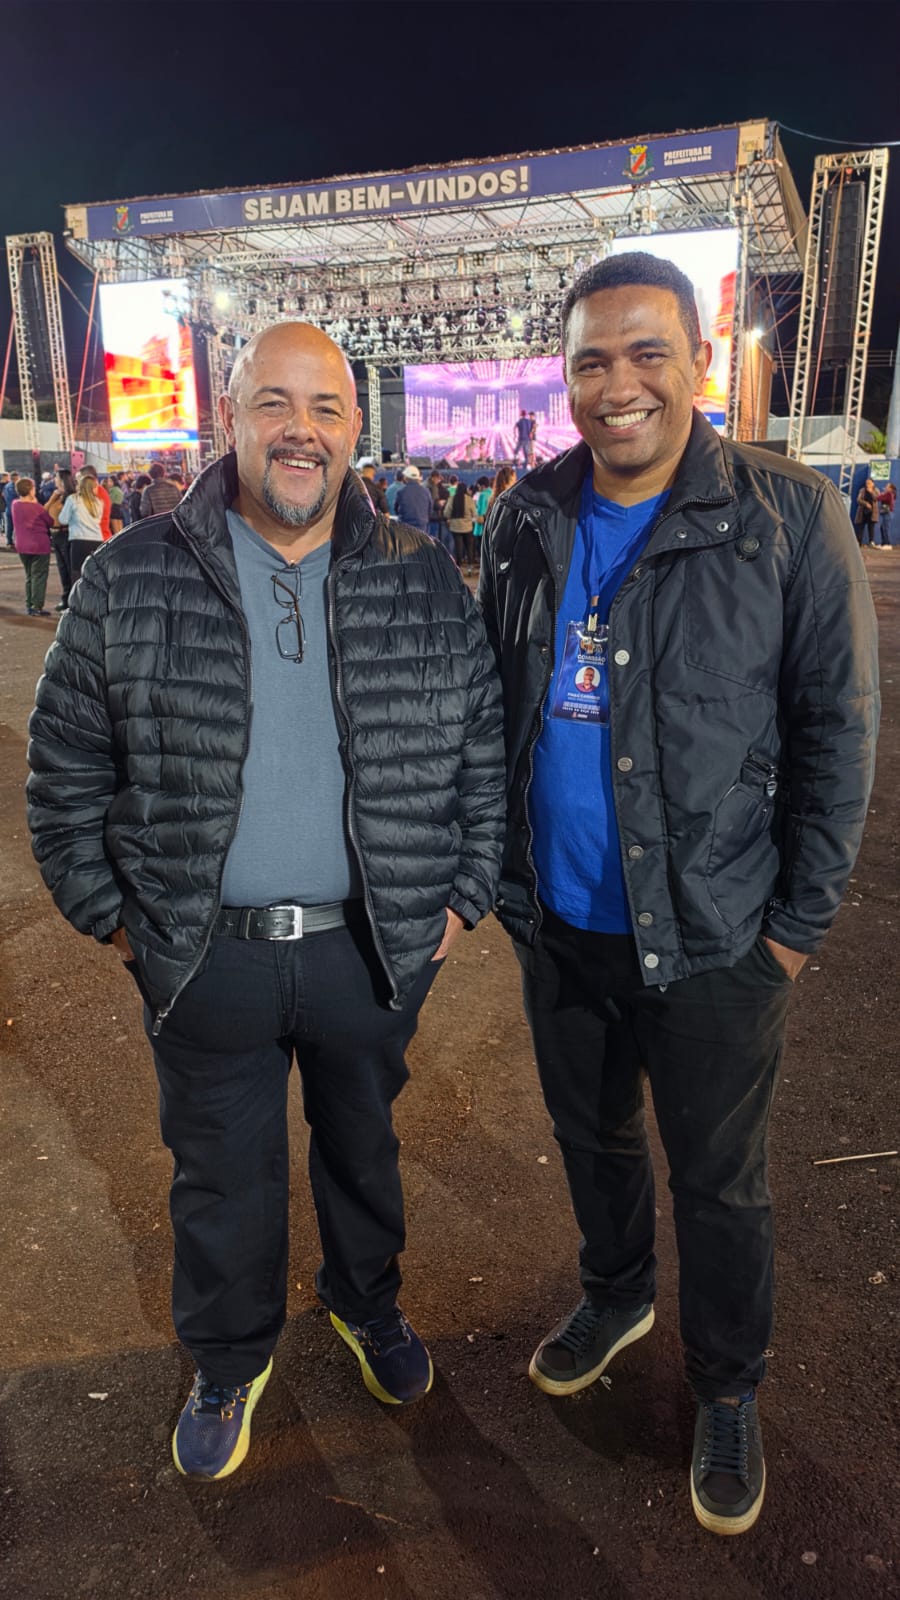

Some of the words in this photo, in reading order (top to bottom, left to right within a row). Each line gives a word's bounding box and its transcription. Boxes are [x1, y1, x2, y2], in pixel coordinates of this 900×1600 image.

[664, 147, 702, 160] PREFEITURA
[244, 192, 329, 220] SEJAM
[335, 166, 529, 213] BEM-VINDOS!
